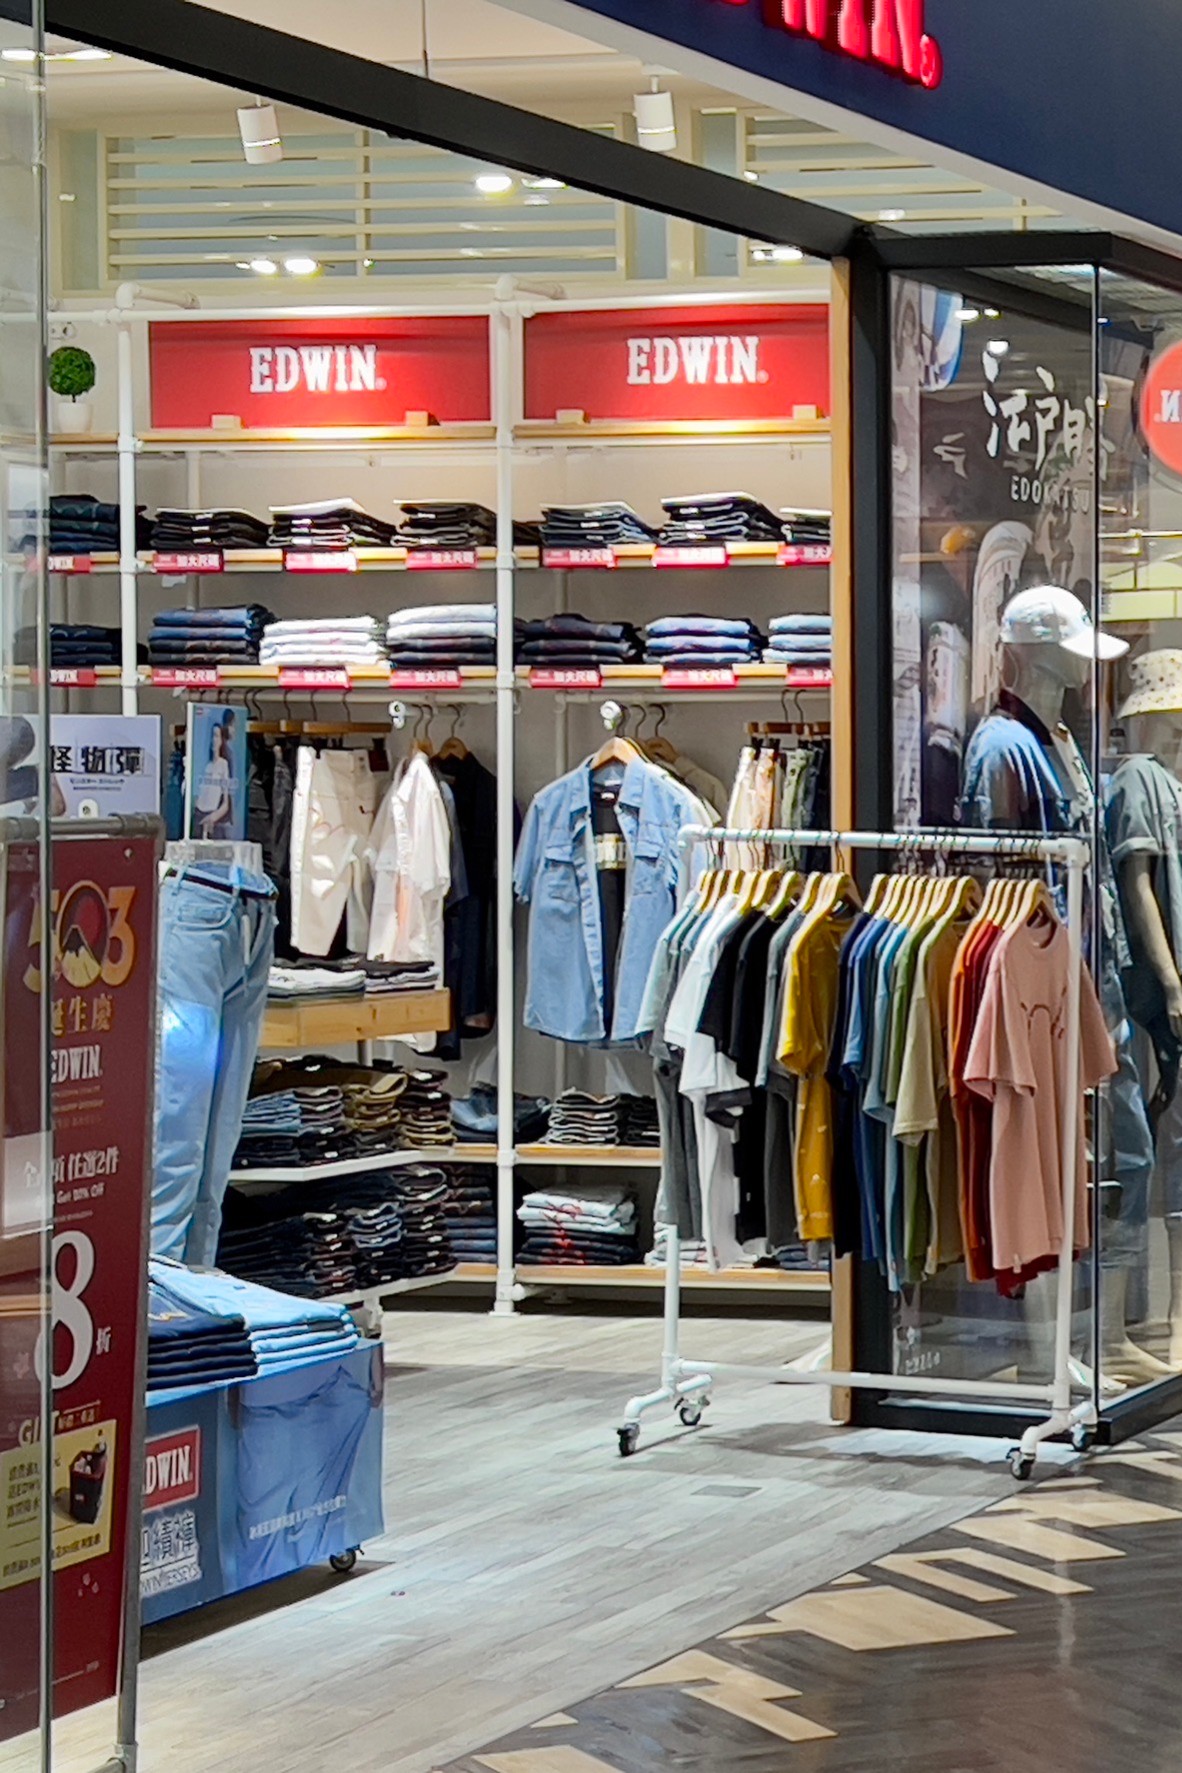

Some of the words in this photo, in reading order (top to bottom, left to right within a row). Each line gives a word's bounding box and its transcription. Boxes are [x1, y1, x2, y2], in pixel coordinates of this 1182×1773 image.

[249, 345, 377, 393] EDWIN
[627, 336, 760, 385] EDWIN
[51, 1044, 101, 1084] EDWIN
[34, 1229, 95, 1390] 8
[18, 1410, 60, 1447] GIT
[144, 1445, 191, 1495] DWIN
